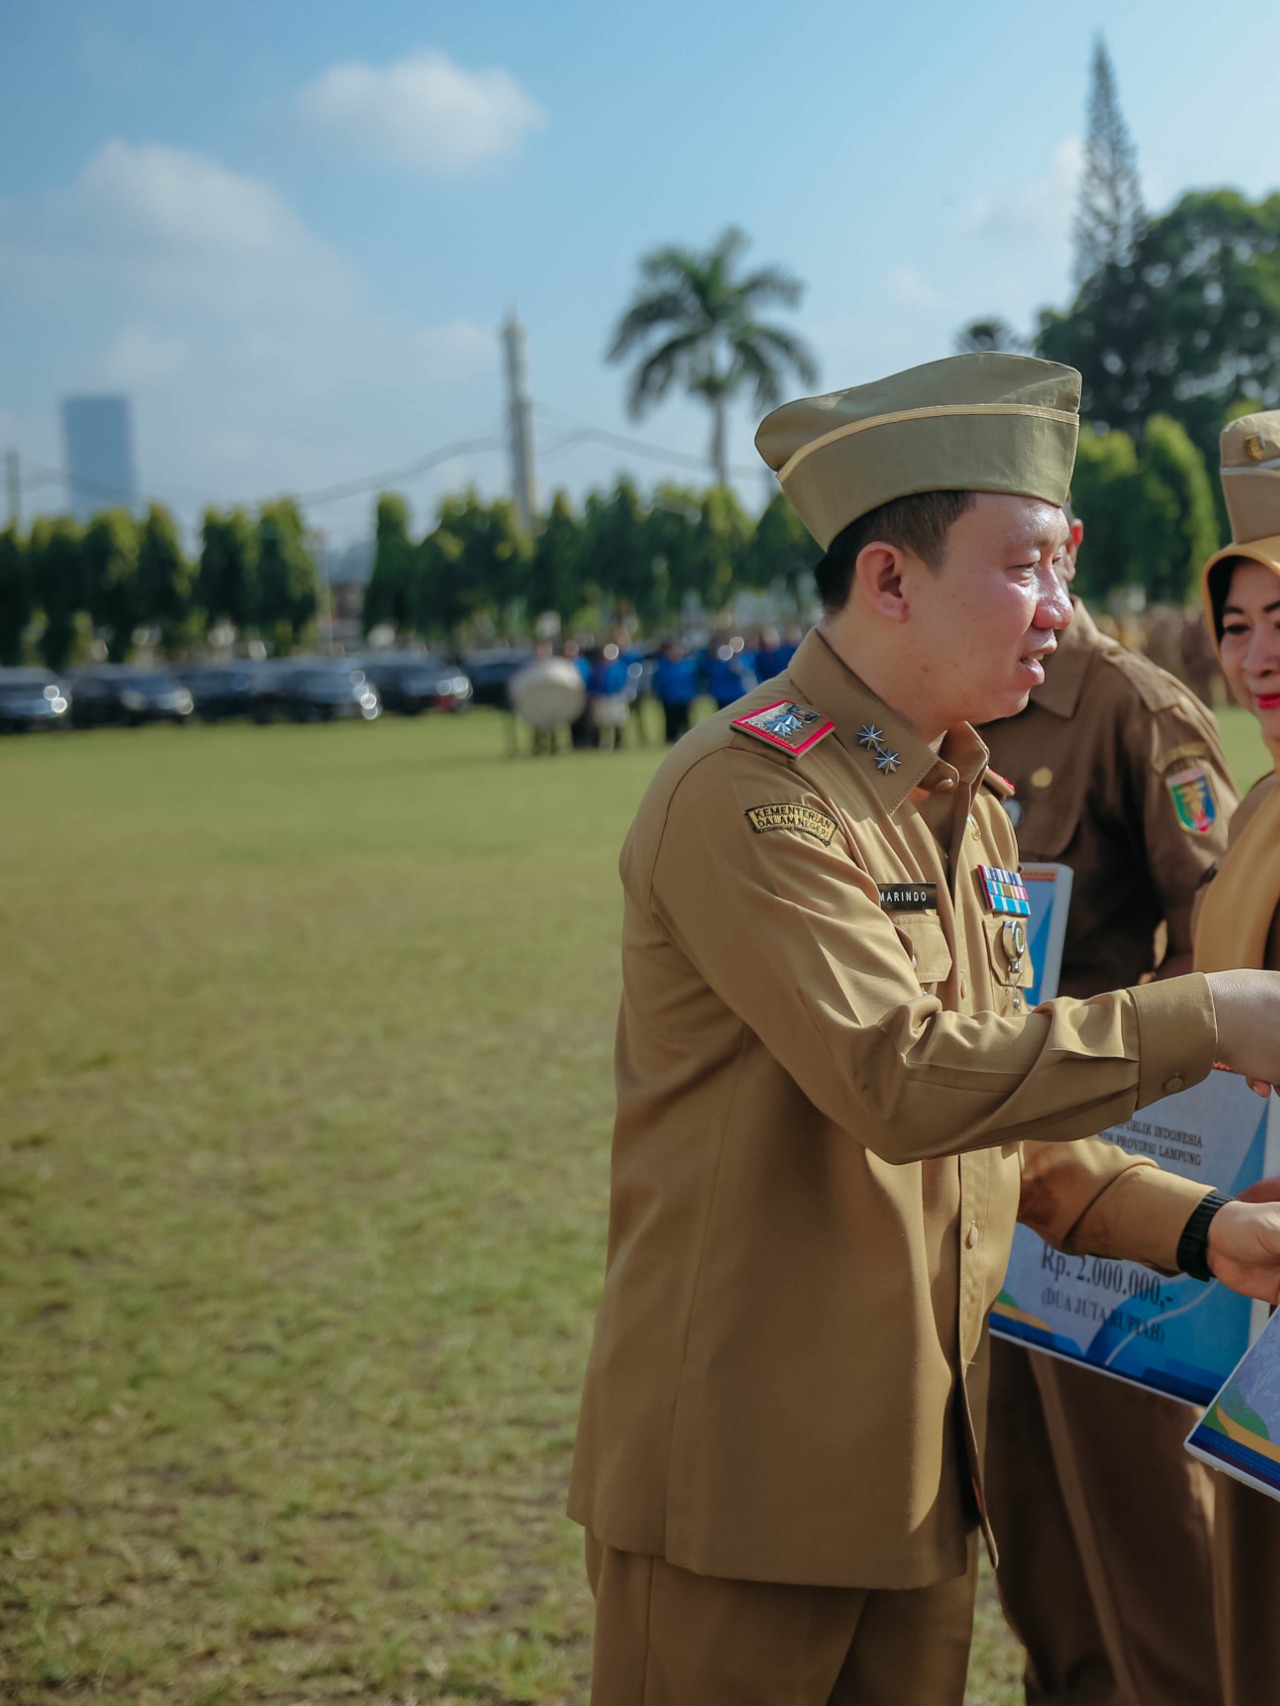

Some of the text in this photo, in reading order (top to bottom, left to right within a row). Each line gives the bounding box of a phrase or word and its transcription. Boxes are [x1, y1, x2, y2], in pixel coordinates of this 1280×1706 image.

[754, 806, 831, 828] KEMENTERIAN
[757, 816, 829, 838] DALAM NEGERI
[1155, 1125, 1202, 1148] INDONESIA
[1158, 1144, 1202, 1166] LAMPUNG
[1041, 1243, 1070, 1281] Rp.
[1042, 1287, 1072, 1312] (DUA
[1074, 1297, 1106, 1320] JUTA
